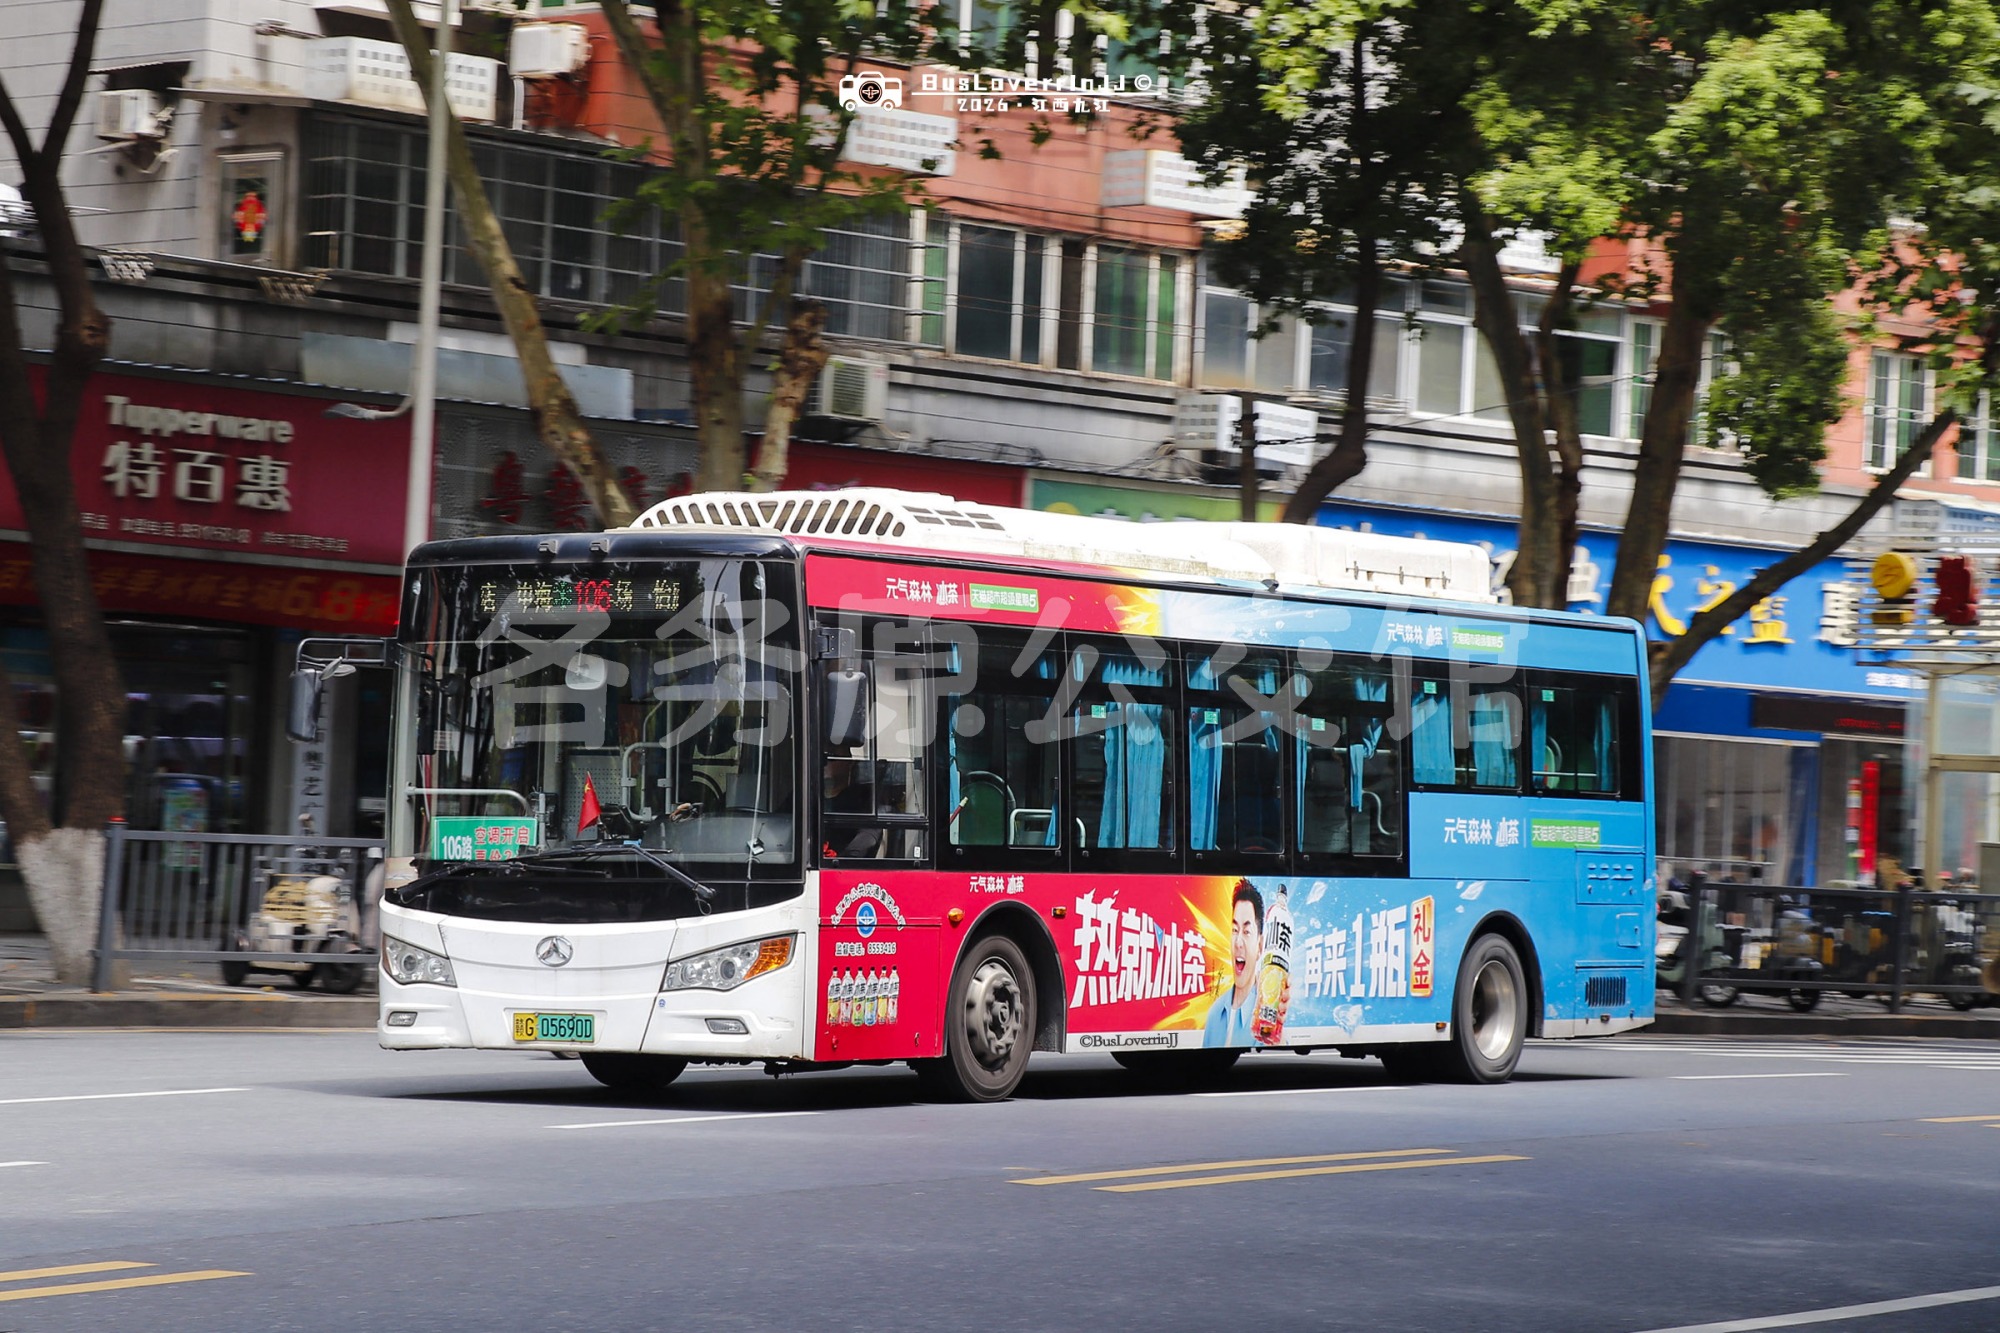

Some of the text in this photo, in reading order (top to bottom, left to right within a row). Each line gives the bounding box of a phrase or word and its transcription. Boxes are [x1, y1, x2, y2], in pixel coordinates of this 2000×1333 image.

[105, 394, 294, 443] Tupperware
[102, 440, 292, 512] 特百惠
[886, 577, 933, 604] 元气森林
[972, 588, 1037, 609] 天猫超市超级星期5
[1387, 623, 1424, 645] 元气森林
[475, 827, 530, 845] 空调开启
[1444, 817, 1493, 845] 元气森林
[441, 836, 473, 861] 106路
[969, 876, 1004, 893] 元气森林
[1069, 888, 1206, 1010] 热就冰茶
[1303, 905, 1408, 999] 再来1瓶
[1413, 906, 1432, 990] 礼金
